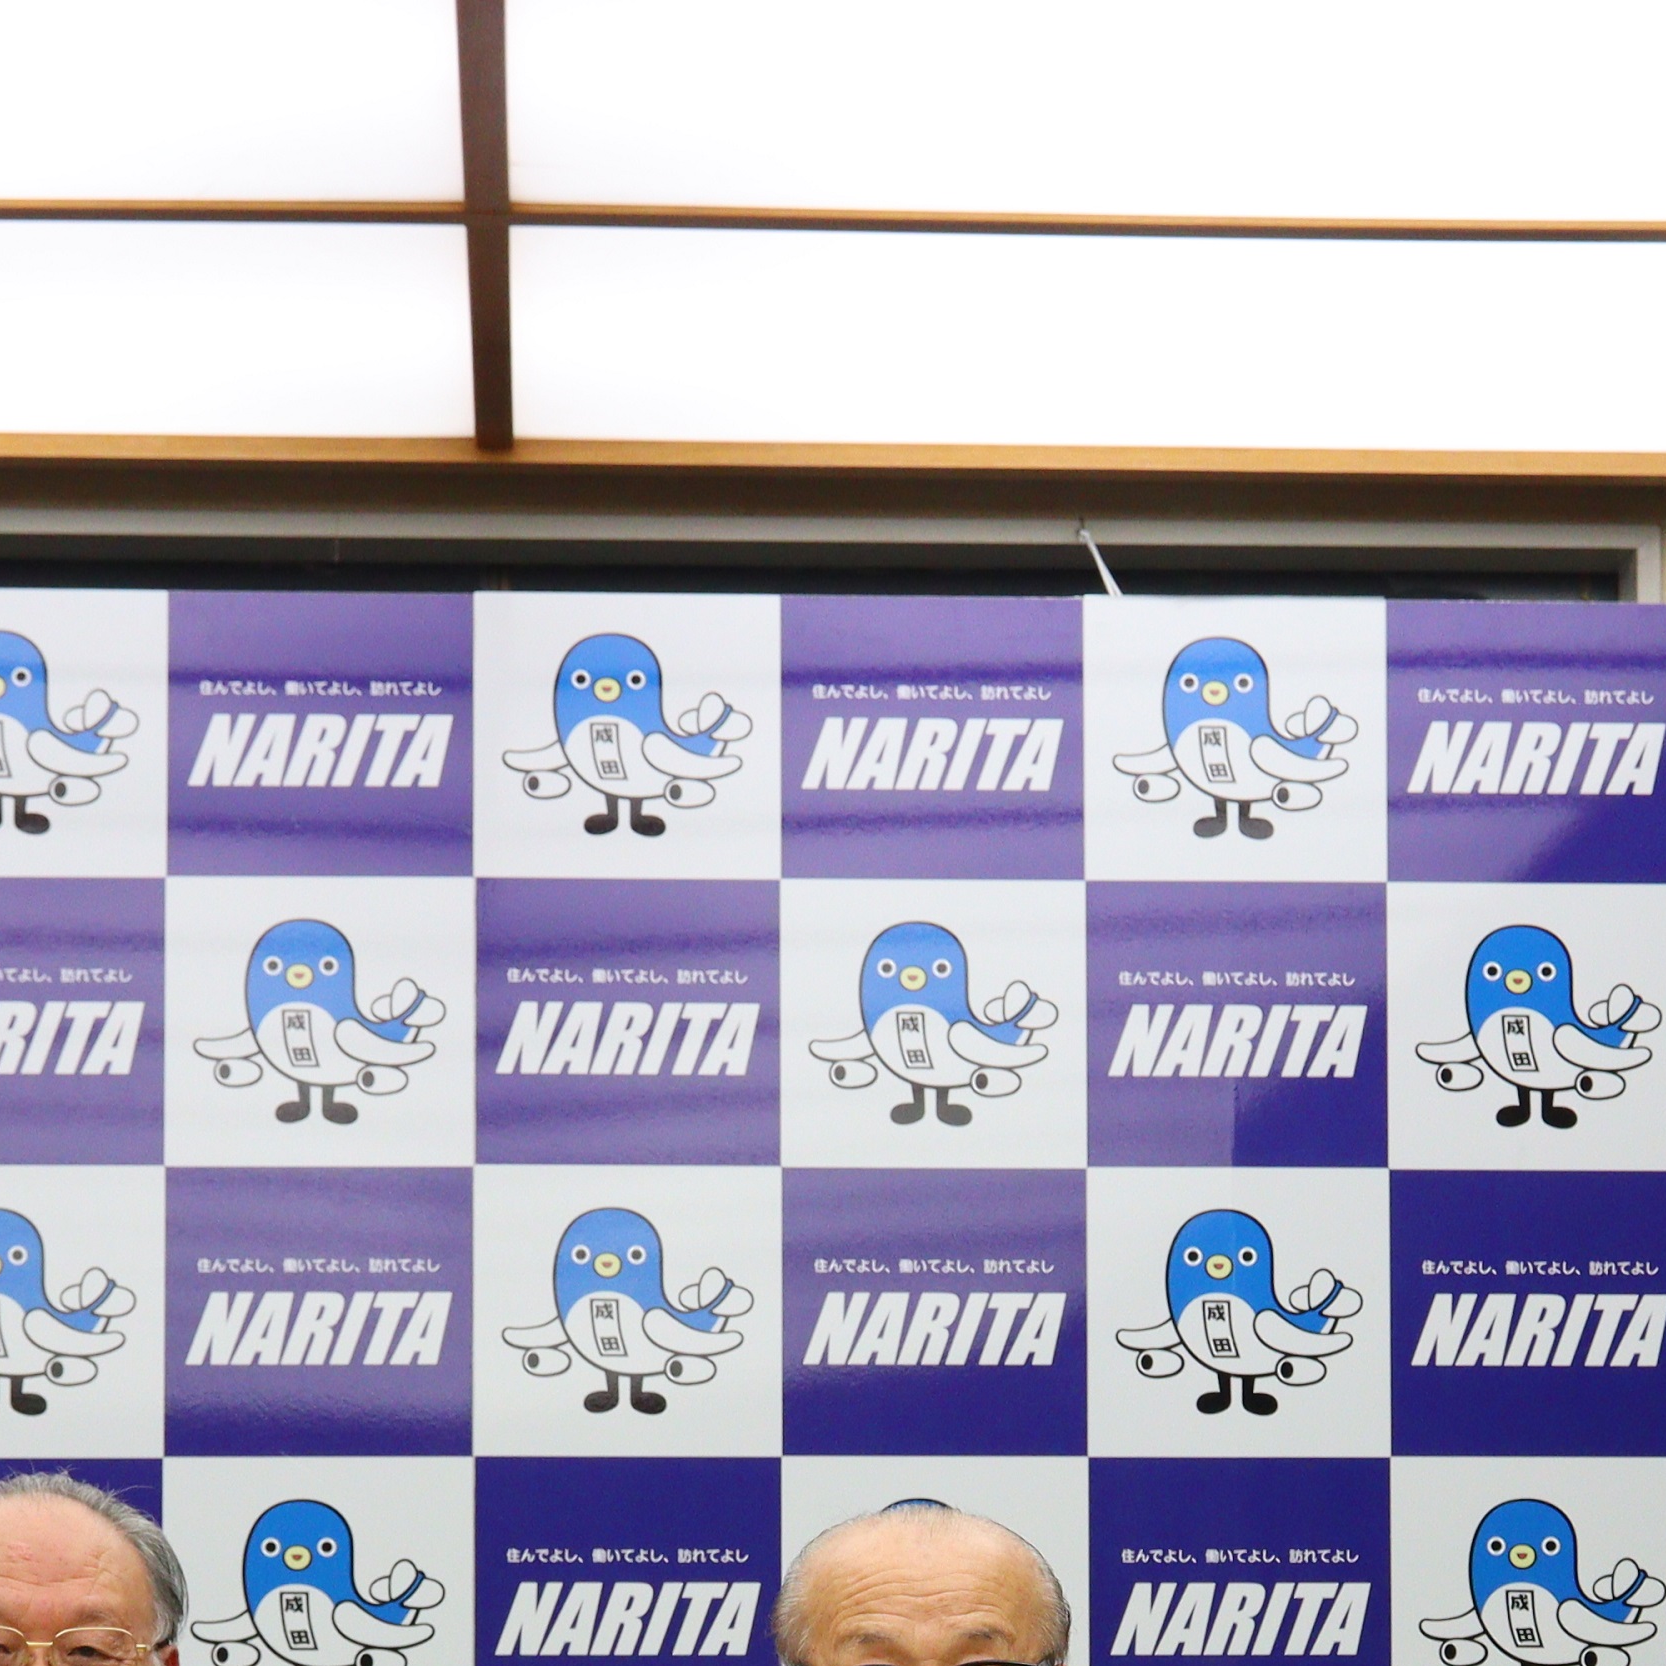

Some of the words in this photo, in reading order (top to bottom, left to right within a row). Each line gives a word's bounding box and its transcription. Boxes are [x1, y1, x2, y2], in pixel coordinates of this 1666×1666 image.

[197, 680, 442, 697] 住んでよし、働いてよし、訪れてよし
[810, 683, 1053, 702] 住んでよし、働いてよし、訪れてよし
[1415, 686, 1655, 706] 住んでよし、働いてよし、訪れてよし
[188, 714, 453, 787] NARITA
[595, 728, 618, 775] 成田
[802, 717, 1063, 791] NARITA
[1202, 732, 1227, 778] 成田
[1407, 721, 1666, 794] NARITA
[505, 967, 749, 985] 住んでよし、働いてよし、訪れてよし
[1117, 970, 1356, 987] 住んでよし、働いてよし、訪れてよし
[286, 1014, 311, 1061] 成田
[496, 1001, 760, 1075] NARITA
[900, 1017, 924, 1064] 成田
[1108, 1004, 1367, 1077] NARITA
[1506, 1018, 1532, 1067] 成田
[195, 1257, 441, 1274] 住んでよし、働いてよし、訪れてよし
[812, 1258, 1055, 1275] 住んでよし、働いてよし、訪れてよし
[1420, 1259, 1659, 1276] 住んでよし、働いてよし、訪れてよし
[186, 1292, 452, 1365] NARITA
[595, 1304, 619, 1351] 成田
[803, 1292, 1066, 1365] NARITA
[1207, 1303, 1233, 1353] 成田
[505, 1547, 749, 1564] 住んでよし、働いてよし、訪れてよし
[1120, 1548, 1360, 1564] 住んでよし、働いてよし、訪れてよし
[284, 1595, 311, 1645] 成田
[495, 1582, 761, 1655] NARITA
[1111, 1583, 1371, 1655] NARITA
[1510, 1593, 1537, 1644] 成田
